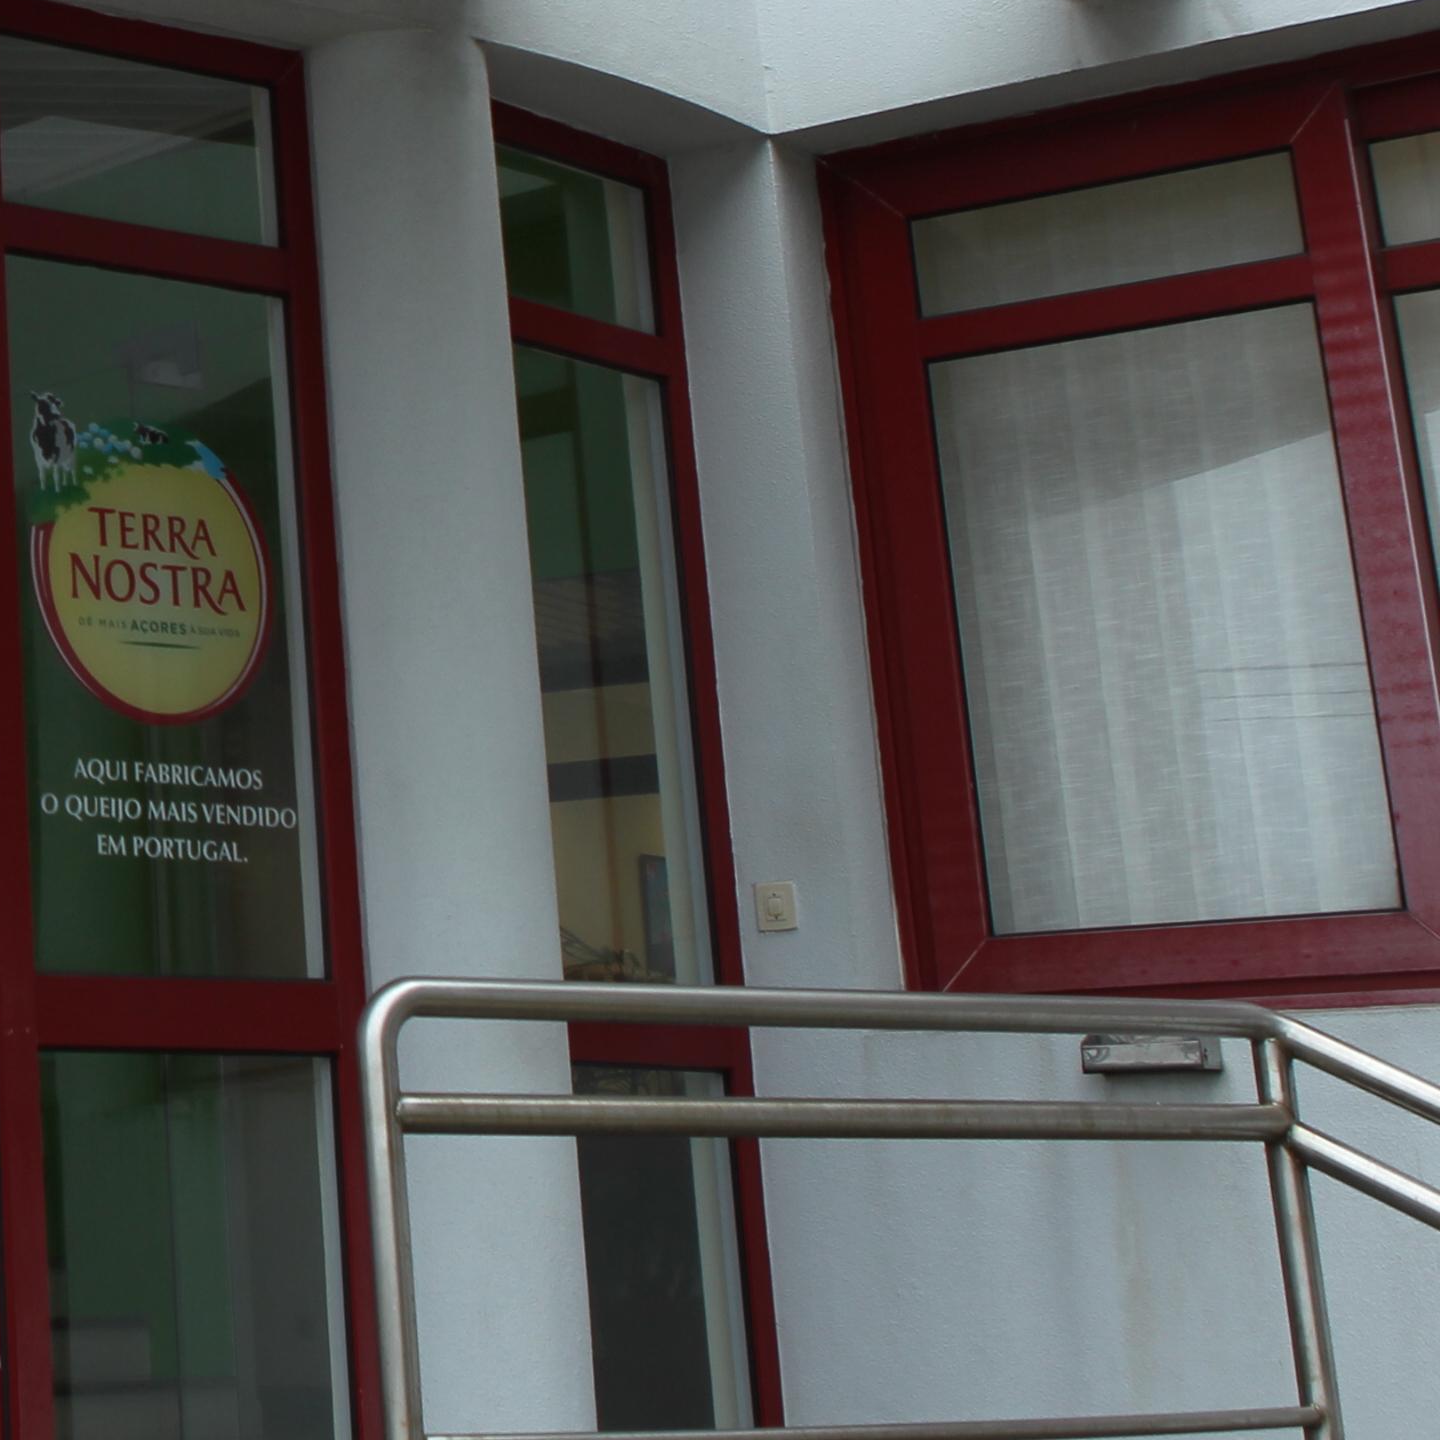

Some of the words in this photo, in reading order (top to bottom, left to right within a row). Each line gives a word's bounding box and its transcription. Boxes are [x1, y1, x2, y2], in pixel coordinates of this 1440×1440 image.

[88, 506, 217, 561] TERRA
[68, 551, 247, 617] NOSTRA
[130, 618, 187, 636] AÇORES
[73, 758, 129, 785] AQUI
[134, 761, 263, 790] FABRICAMOS
[40, 792, 59, 815] O
[65, 794, 142, 823] QUEIJO
[147, 800, 198, 824] MAIS
[201, 803, 297, 829] VENDIDO
[96, 834, 126, 857] EM
[133, 836, 249, 863] PORTUGAL.
